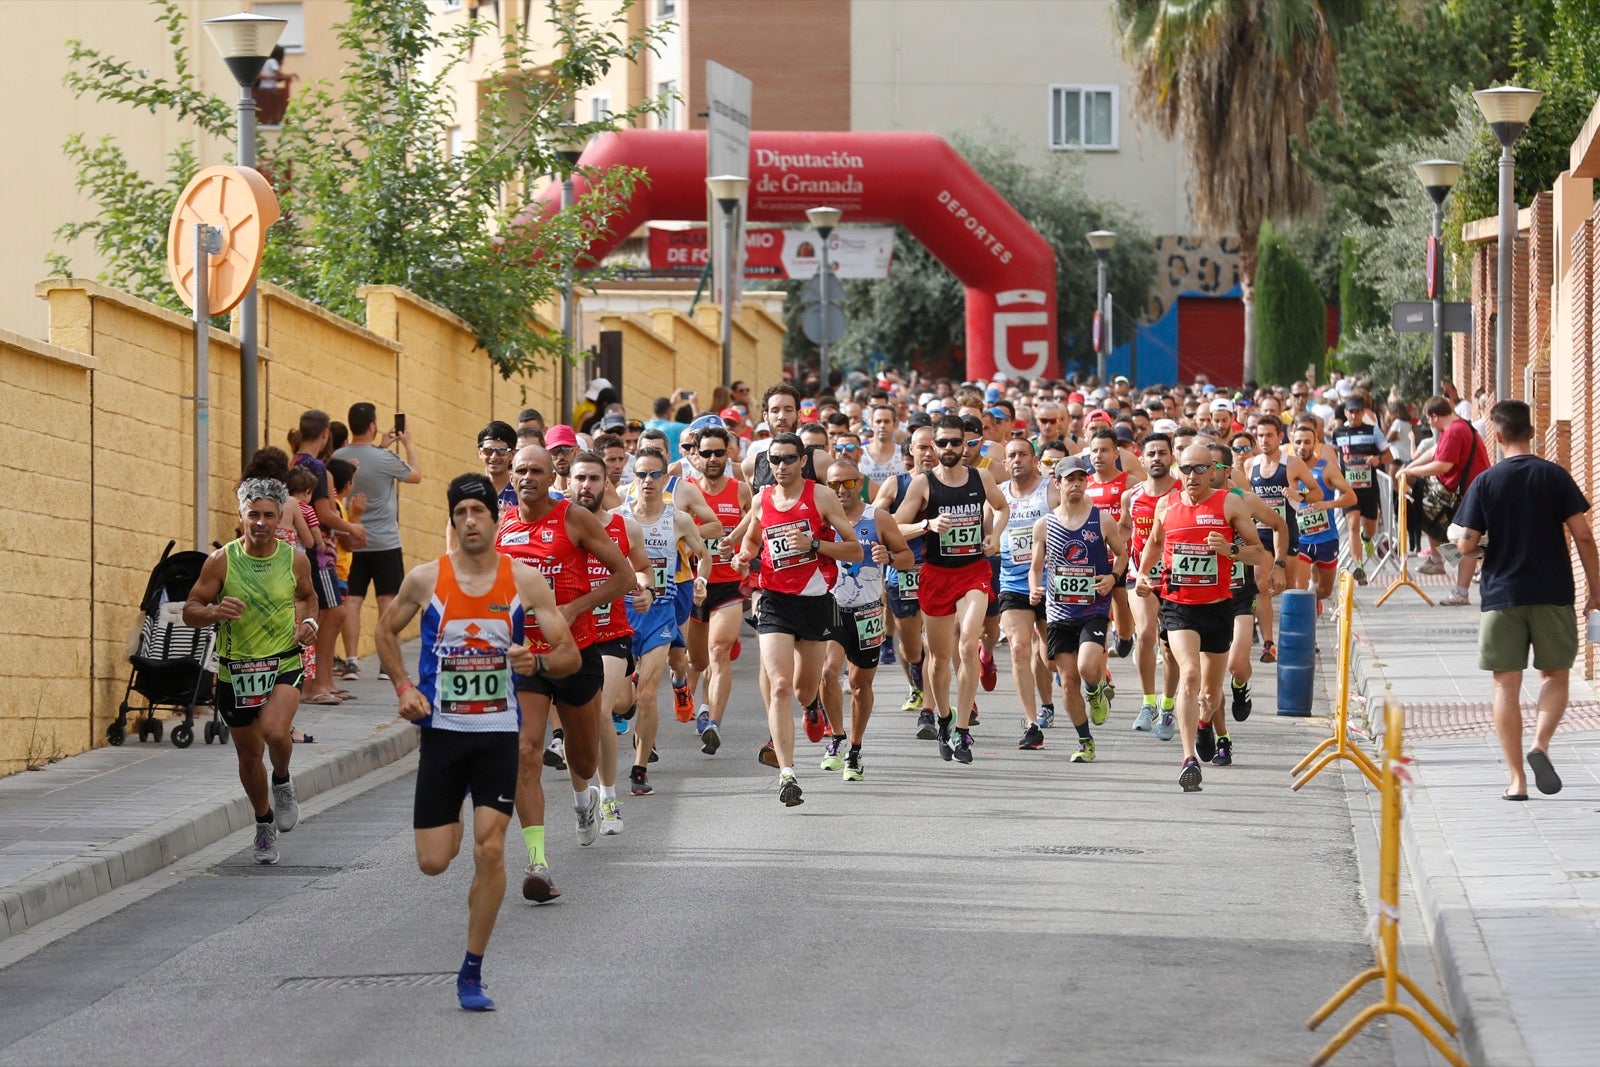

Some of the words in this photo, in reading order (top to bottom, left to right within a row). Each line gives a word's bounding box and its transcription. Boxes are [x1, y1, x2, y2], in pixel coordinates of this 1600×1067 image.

[755, 149, 864, 172] Diputación
[756, 172, 780, 193] de
[781, 173, 864, 194] Granada
[937, 190, 1013, 265] DEPORTES
[667, 248, 688, 263] DE
[938, 502, 981, 515] GRANADA
[1303, 512, 1325, 527] 534
[948, 527, 977, 543] 157
[772, 538, 790, 554] 30
[1178, 556, 1212, 572] 477
[1060, 577, 1089, 593] 682
[236, 673, 276, 693] 1110
[452, 674, 499, 697] 910
